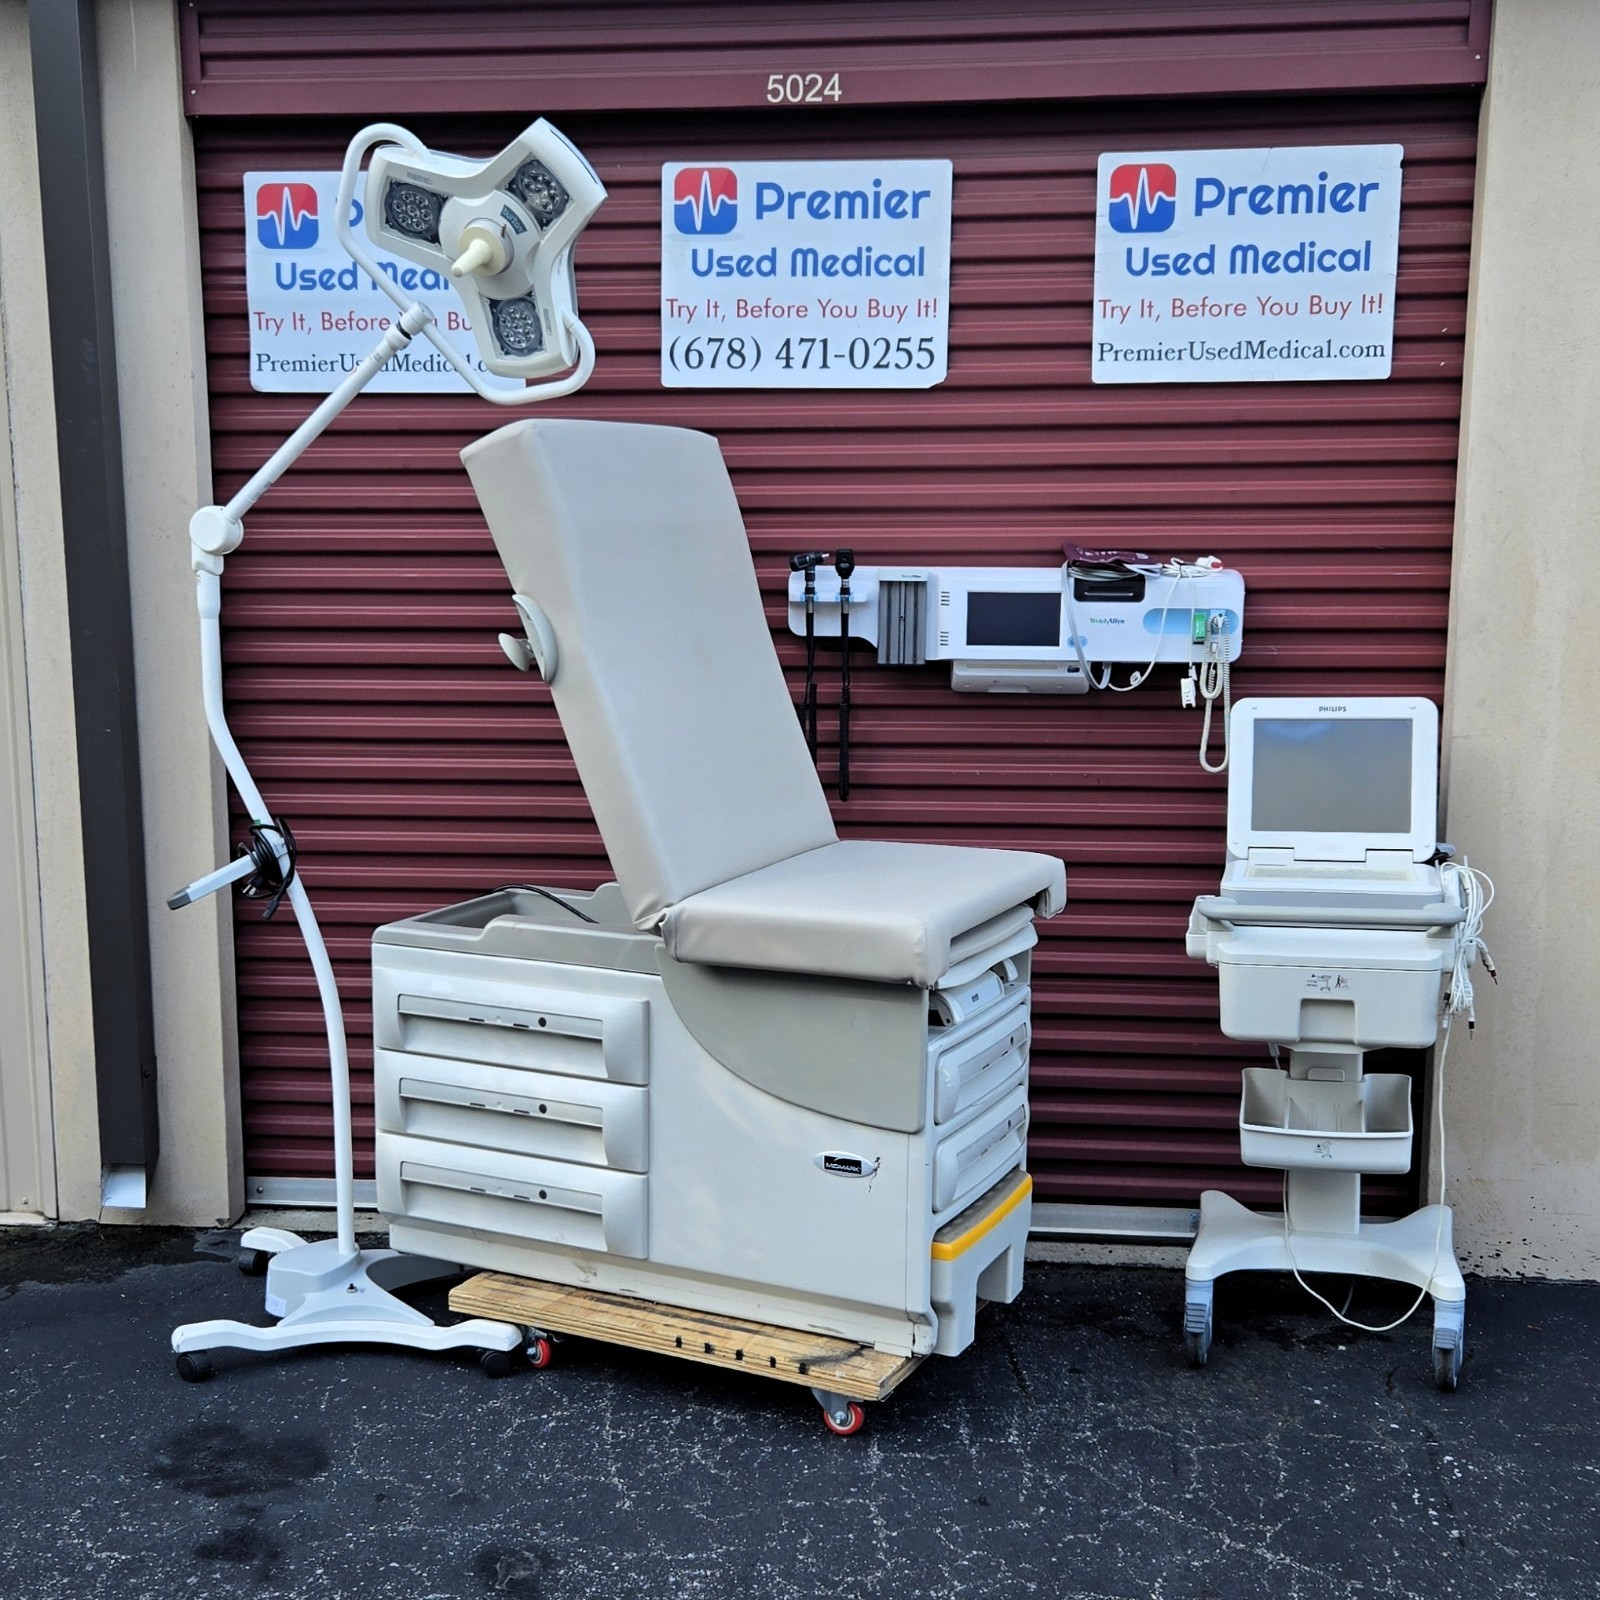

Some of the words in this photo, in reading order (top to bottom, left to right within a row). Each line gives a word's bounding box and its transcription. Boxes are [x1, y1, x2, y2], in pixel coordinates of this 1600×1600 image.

[766, 73, 842, 103] 5024
[756, 178, 931, 220] Premier
[1195, 171, 1380, 216] Premier
[692, 247, 778, 277] Used
[791, 246, 925, 277] Medical
[1126, 243, 1216, 276] Used
[1229, 240, 1371, 274] Medical
[276, 262, 358, 291] Used
[253, 311, 284, 336] Try
[292, 311, 312, 334] It,
[321, 310, 391, 331] Before
[666, 298, 697, 324] Try
[706, 298, 726, 322] It,
[737, 298, 808, 318] Before
[817, 298, 858, 318] You
[868, 298, 908, 324] Buy
[917, 298, 937, 318] It!
[1099, 299, 1131, 325] Try
[1140, 299, 1160, 322] It,
[1171, 296, 1247, 318] Before
[1257, 296, 1299, 316] You
[1309, 294, 1352, 320] Buy
[1361, 293, 1383, 314] It!
[669, 336, 762, 371] (678)
[775, 337, 935, 369] 471-0255
[1098, 339, 1386, 362] PremierUsedMedical.com
